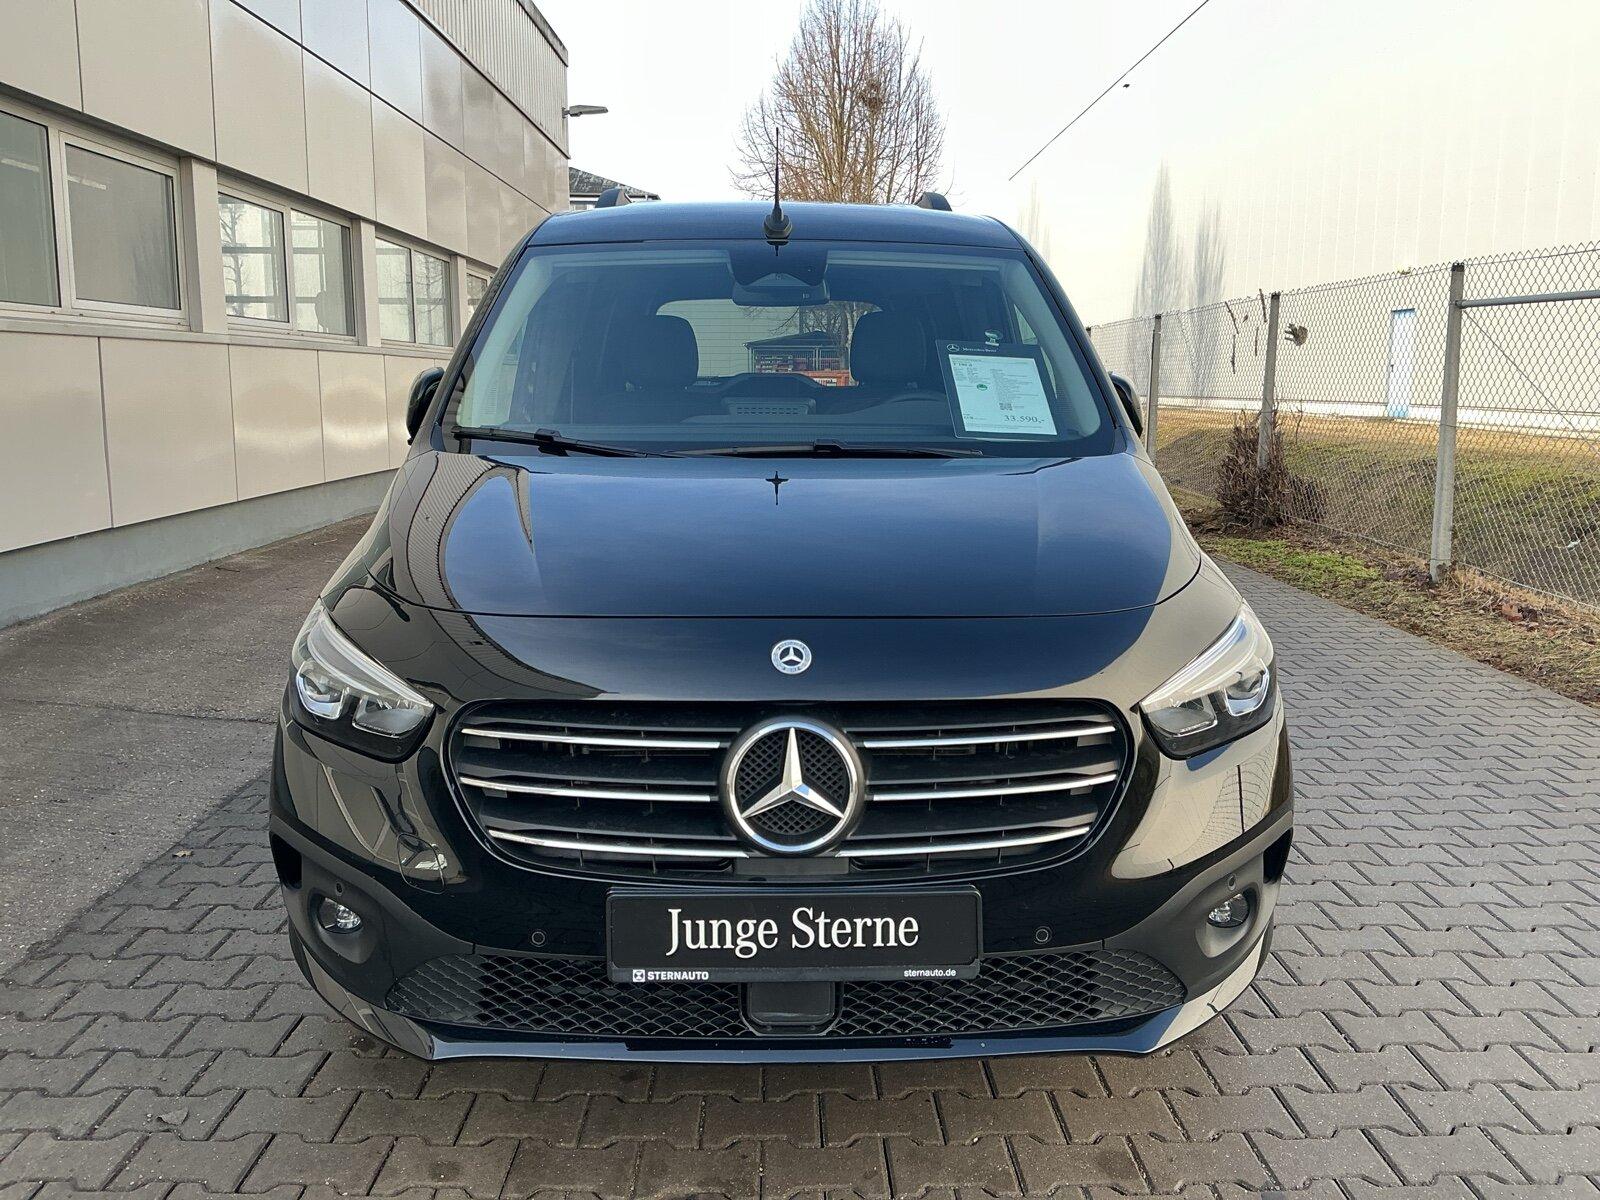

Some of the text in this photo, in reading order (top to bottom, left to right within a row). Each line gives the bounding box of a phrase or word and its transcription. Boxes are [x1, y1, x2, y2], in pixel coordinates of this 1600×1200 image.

[665, 906, 919, 959] Junge Sterne
[647, 971, 709, 981] STERNAUTO
[903, 968, 957, 978] sternauto.de
